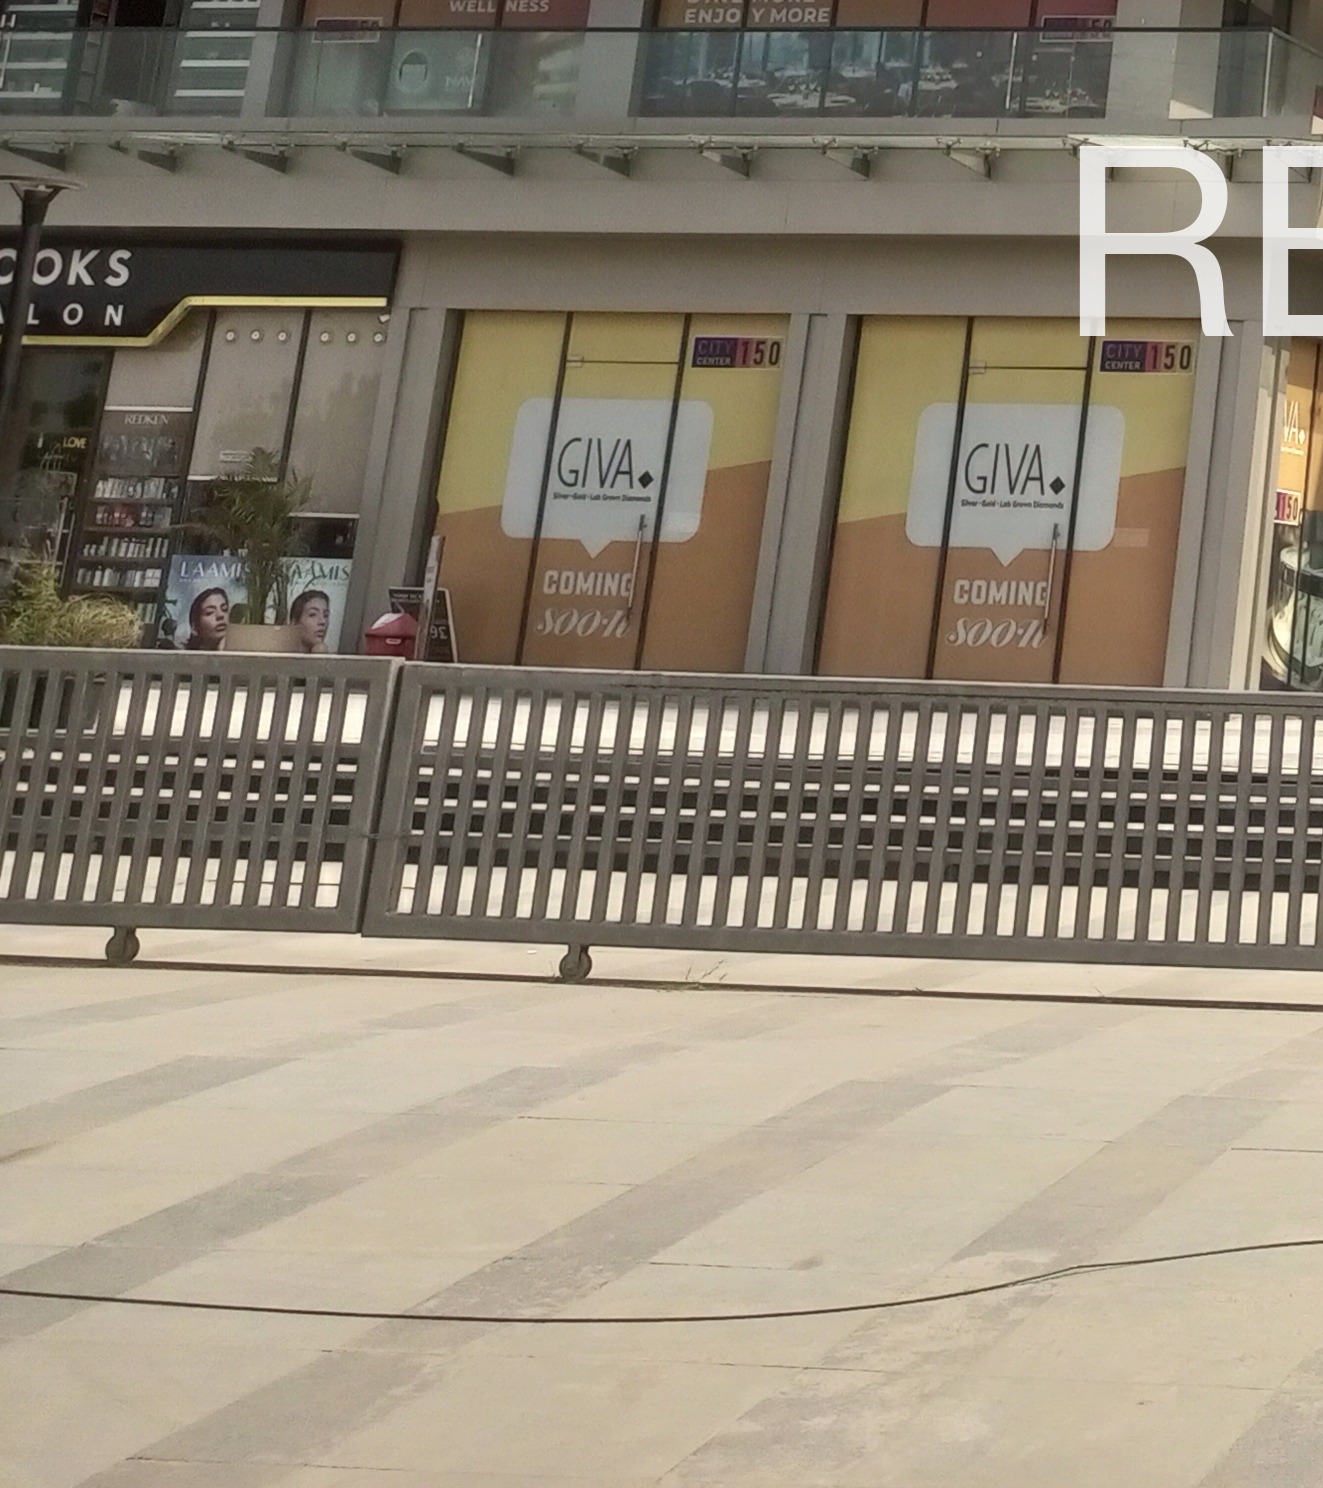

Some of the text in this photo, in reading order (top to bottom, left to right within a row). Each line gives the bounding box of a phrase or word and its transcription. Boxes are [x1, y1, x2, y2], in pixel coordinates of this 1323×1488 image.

[770, 7, 831, 23] MORE
[0, 248, 133, 287] OOKS
[0, 304, 124, 327] LON
[698, 340, 735, 354] CITY
[1106, 344, 1192, 370] CITY 150
[696, 356, 732, 366] CENTER
[1105, 361, 1141, 370] CENTER
[124, 414, 169, 425] REDKEN
[63, 436, 87, 449] LOVE
[557, 437, 635, 490] GIVA
[963, 442, 1045, 496] GIVA
[543, 570, 633, 598] COMING
[953, 579, 1048, 608] COMING
